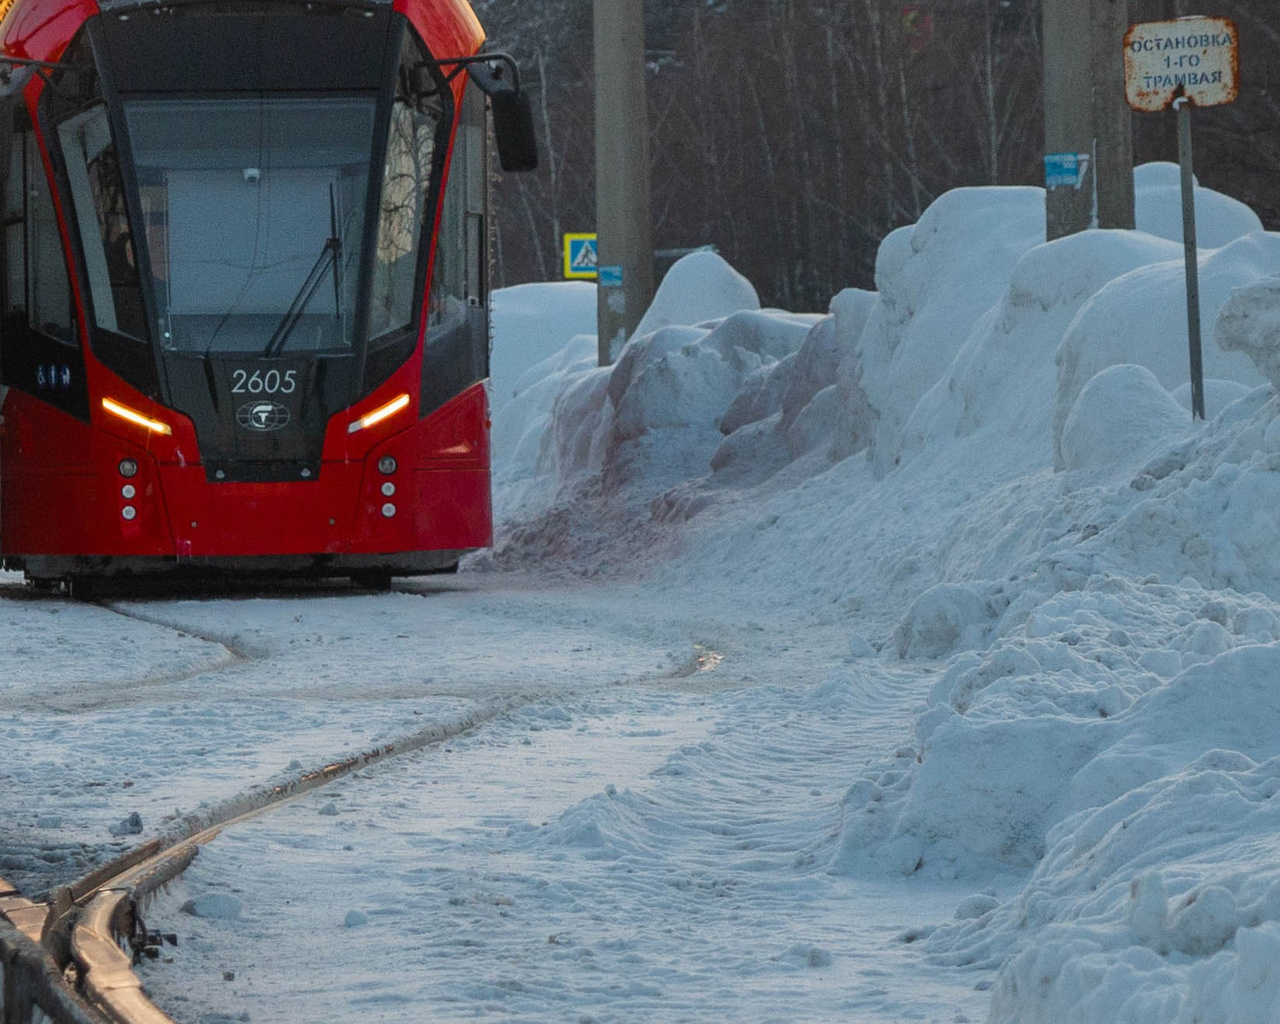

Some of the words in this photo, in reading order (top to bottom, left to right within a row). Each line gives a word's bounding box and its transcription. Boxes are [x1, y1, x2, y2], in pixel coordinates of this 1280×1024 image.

[1131, 33, 1233, 52] ОСТАНОВКА
[1164, 54, 1200, 68] 1-ГО
[1143, 71, 1222, 88] ТРАМВАЯ
[231, 369, 297, 393] 2605
